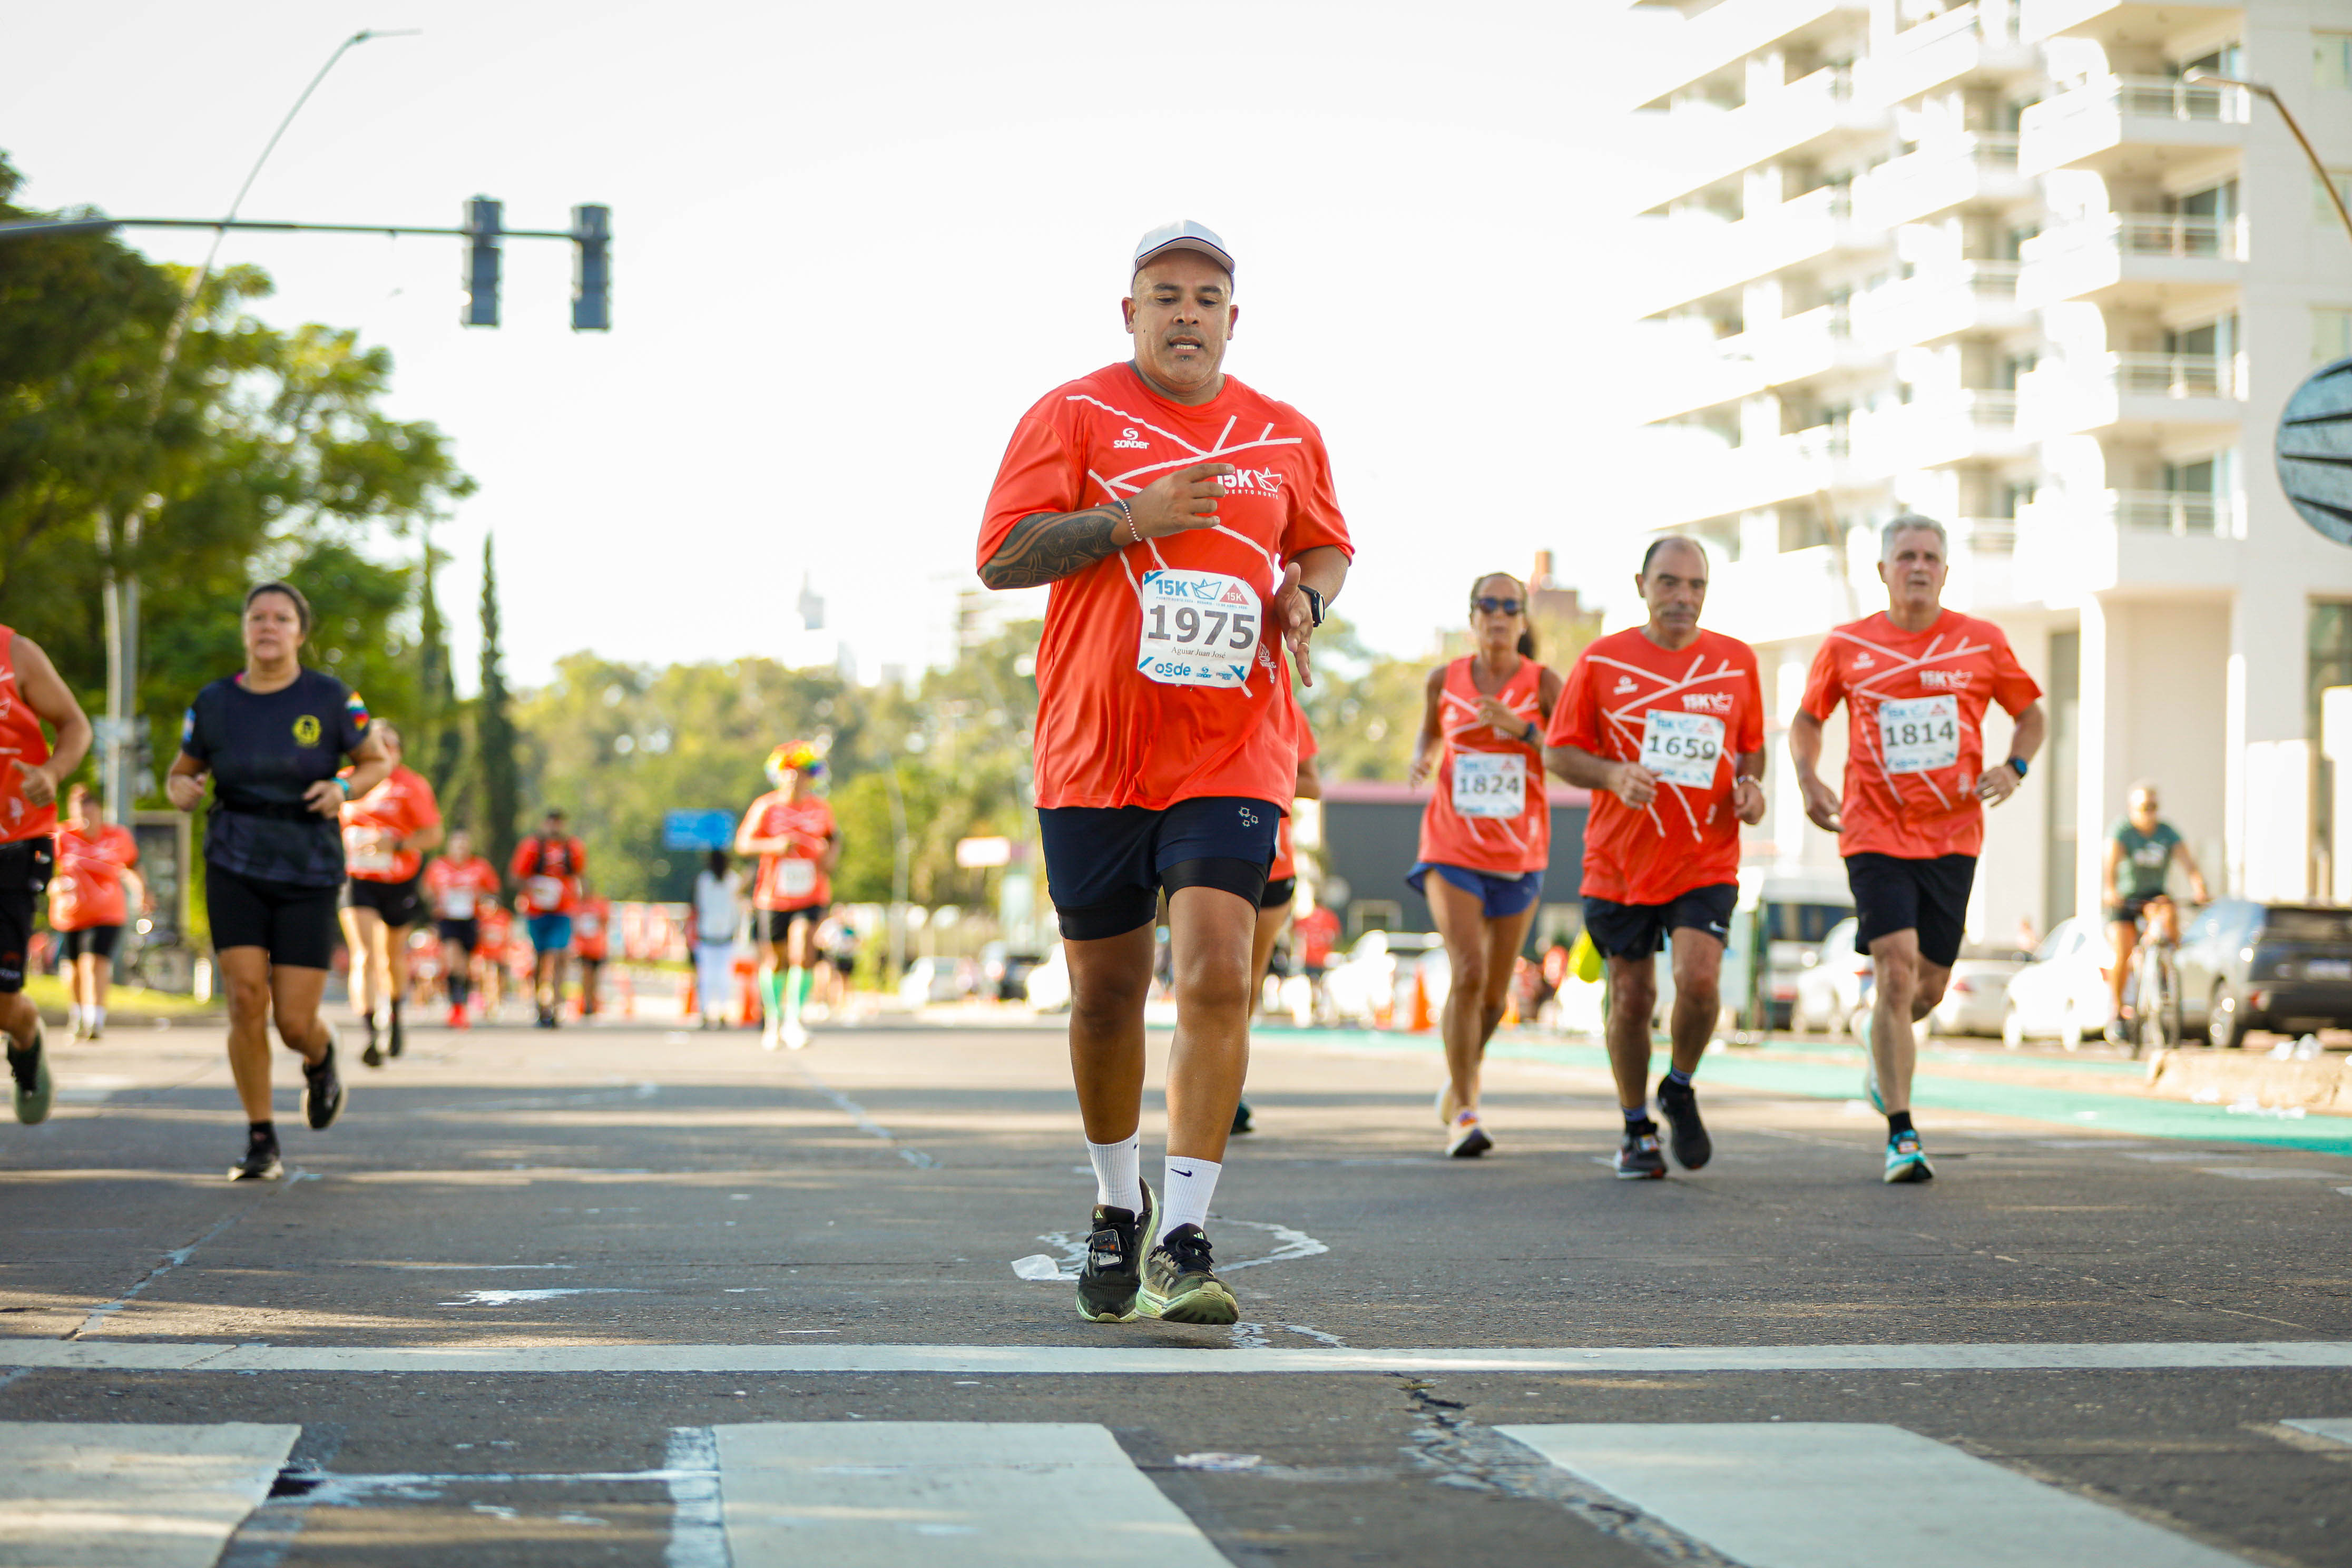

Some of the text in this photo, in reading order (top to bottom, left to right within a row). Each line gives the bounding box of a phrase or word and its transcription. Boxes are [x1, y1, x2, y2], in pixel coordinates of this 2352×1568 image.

[1258, 491, 1278, 499] NORTE
[1155, 579, 1188, 596] 15K
[1227, 592, 1242, 602] 15K
[1148, 605, 1255, 649] 1975
[1171, 646, 1194, 655] Aguiar
[1155, 662, 1191, 677] osde
[1886, 721, 1955, 747] 1814
[1648, 734, 1716, 760] 1659
[1458, 775, 1519, 795] 1824
